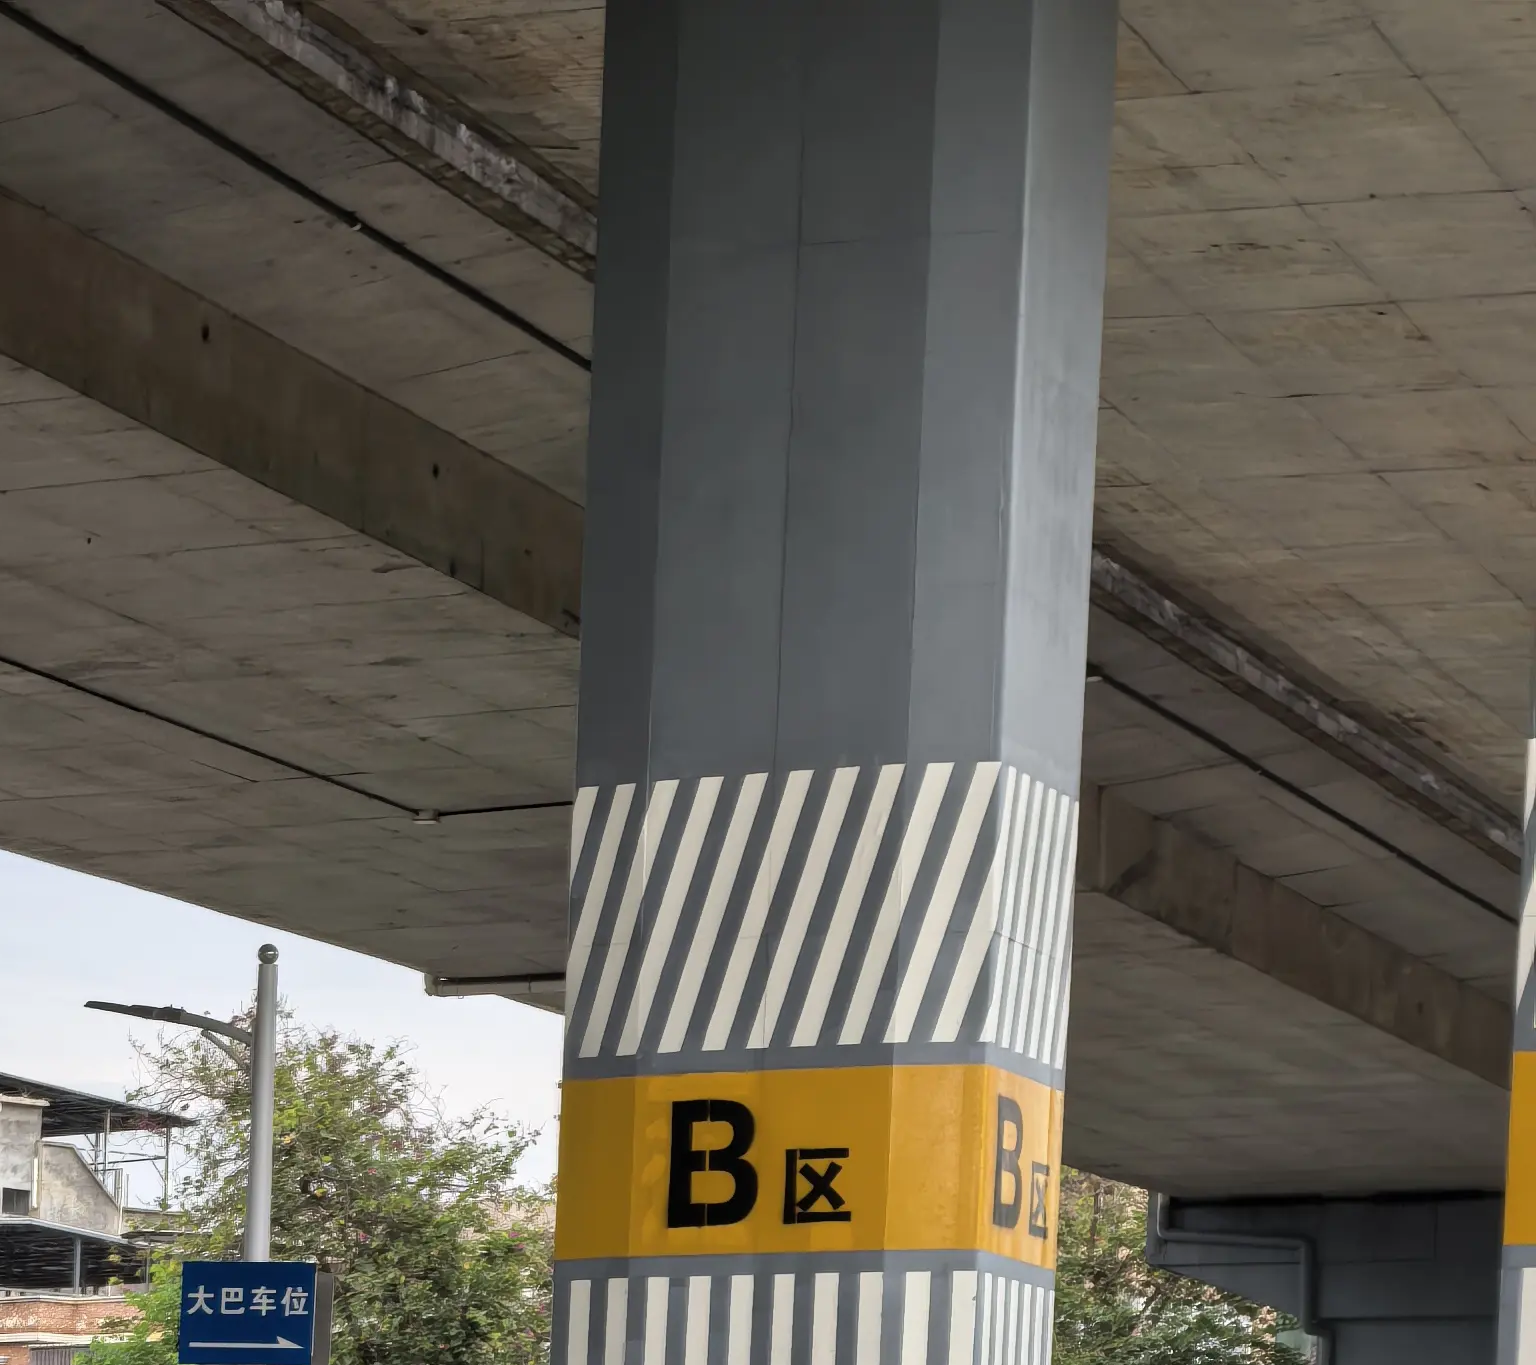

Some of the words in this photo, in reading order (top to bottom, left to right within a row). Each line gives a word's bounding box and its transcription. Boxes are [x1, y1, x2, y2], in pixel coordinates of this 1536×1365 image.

[667, 1099, 851, 1229] B区
[993, 1094, 1049, 1239] B区
[186, 1285, 309, 1317] 大巴车位
